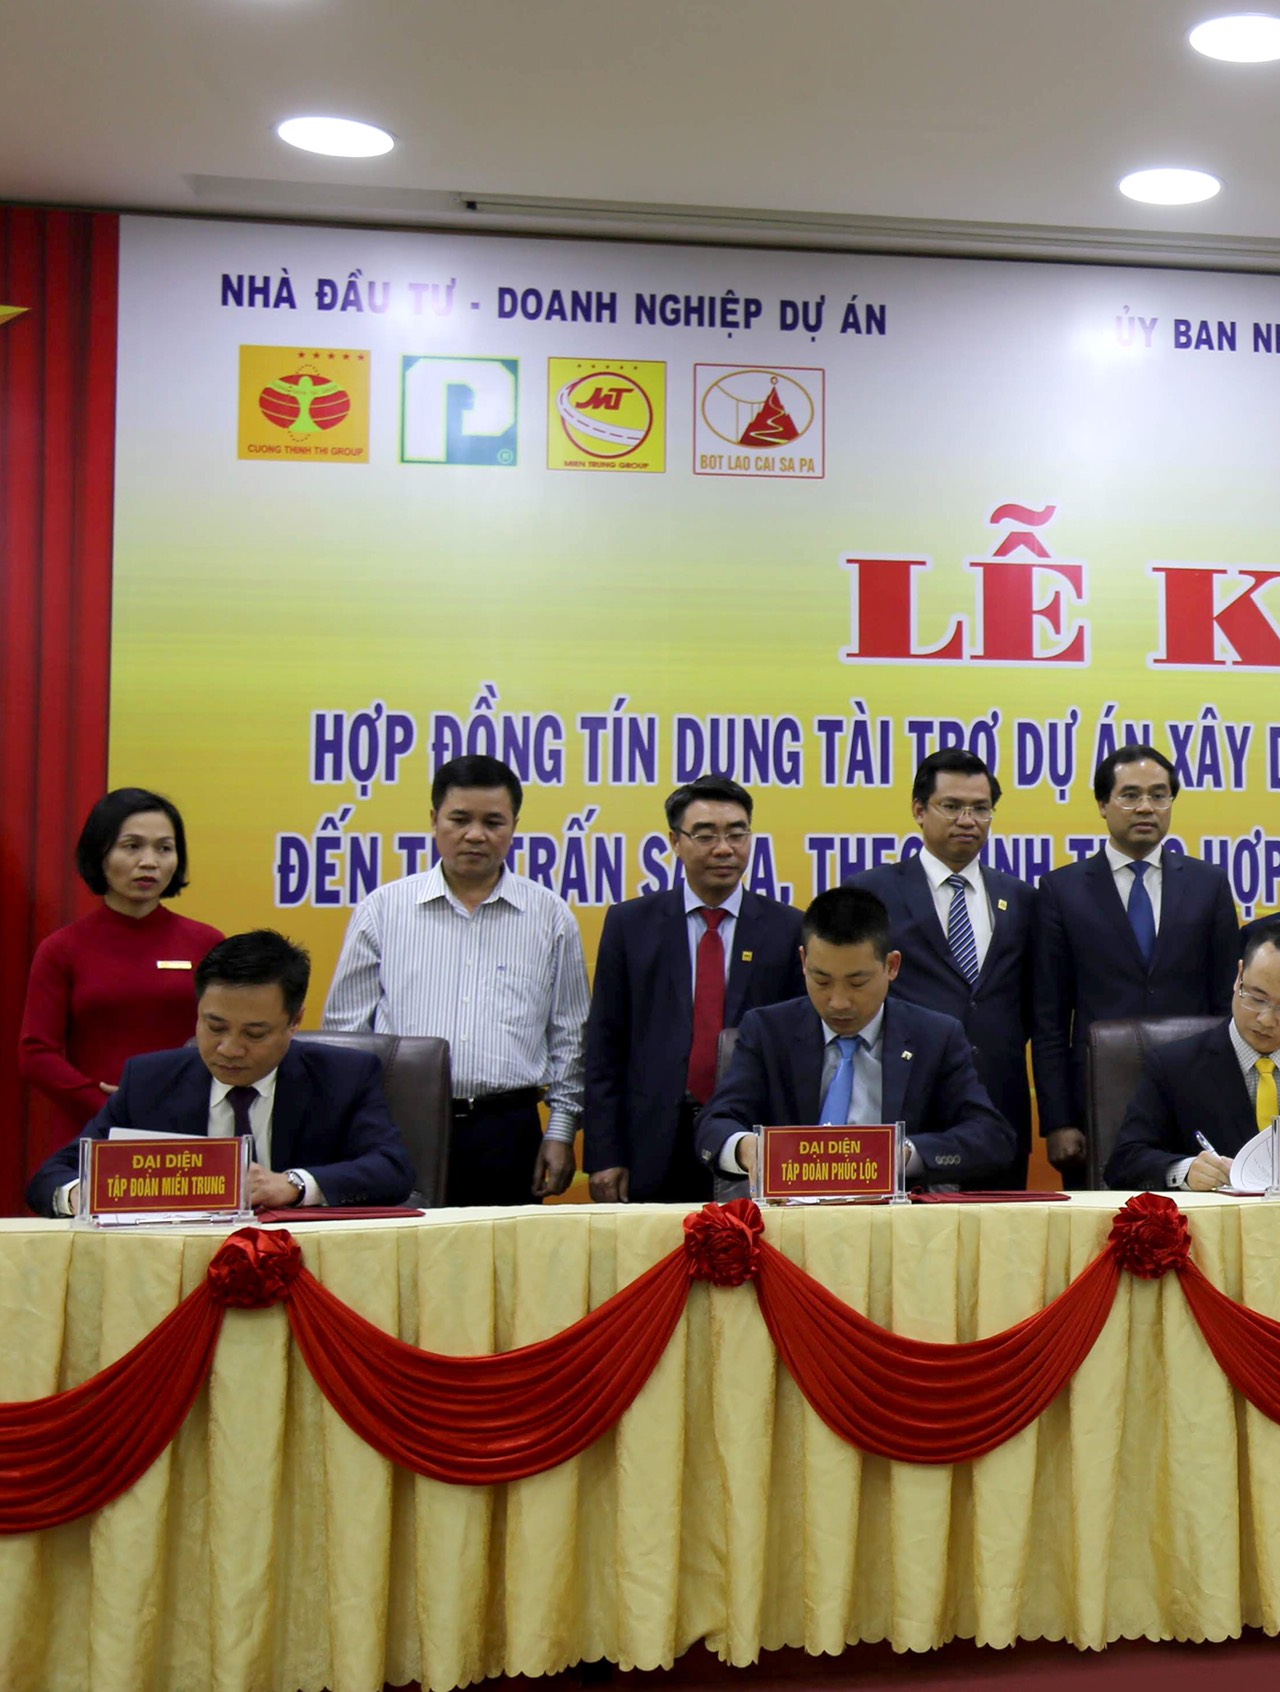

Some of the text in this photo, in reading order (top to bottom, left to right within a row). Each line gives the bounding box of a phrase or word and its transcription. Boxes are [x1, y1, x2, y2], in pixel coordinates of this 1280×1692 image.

[221, 266, 297, 310] NHÀ
[315, 268, 390, 314] ĐẦU
[408, 277, 457, 316] TƯ
[498, 287, 619, 324] DOANH
[635, 290, 763, 339] NGHIỆP
[779, 294, 826, 343] DỰ
[841, 289, 888, 337] ÁN
[1174, 319, 1237, 352] BAN
[248, 444, 281, 454] CUONG
[331, 447, 363, 456] GROUP
[700, 454, 815, 473] BOT LAO CAI SA PA
[588, 461, 616, 469] TRUNG
[619, 462, 649, 470] GROUP
[846, 504, 1085, 662] LỄ
[315, 703, 414, 796] HỢP
[432, 685, 562, 783] ĐỒNG
[581, 698, 656, 782] TÍN
[818, 702, 890, 784] TÀI
[1018, 710, 1078, 801] DỰ
[1169, 707, 1251, 788] XÂY
[278, 808, 379, 904] ĐẾN
[132, 1151, 203, 1173] ĐẠI DIỆN
[799, 1138, 860, 1158] ĐẠI DIỆN
[107, 1170, 225, 1201] TẬP ĐOÀN MIỀN TRUNG
[781, 1158, 878, 1185] TẬP ĐOÀN PHÚC LỘC
